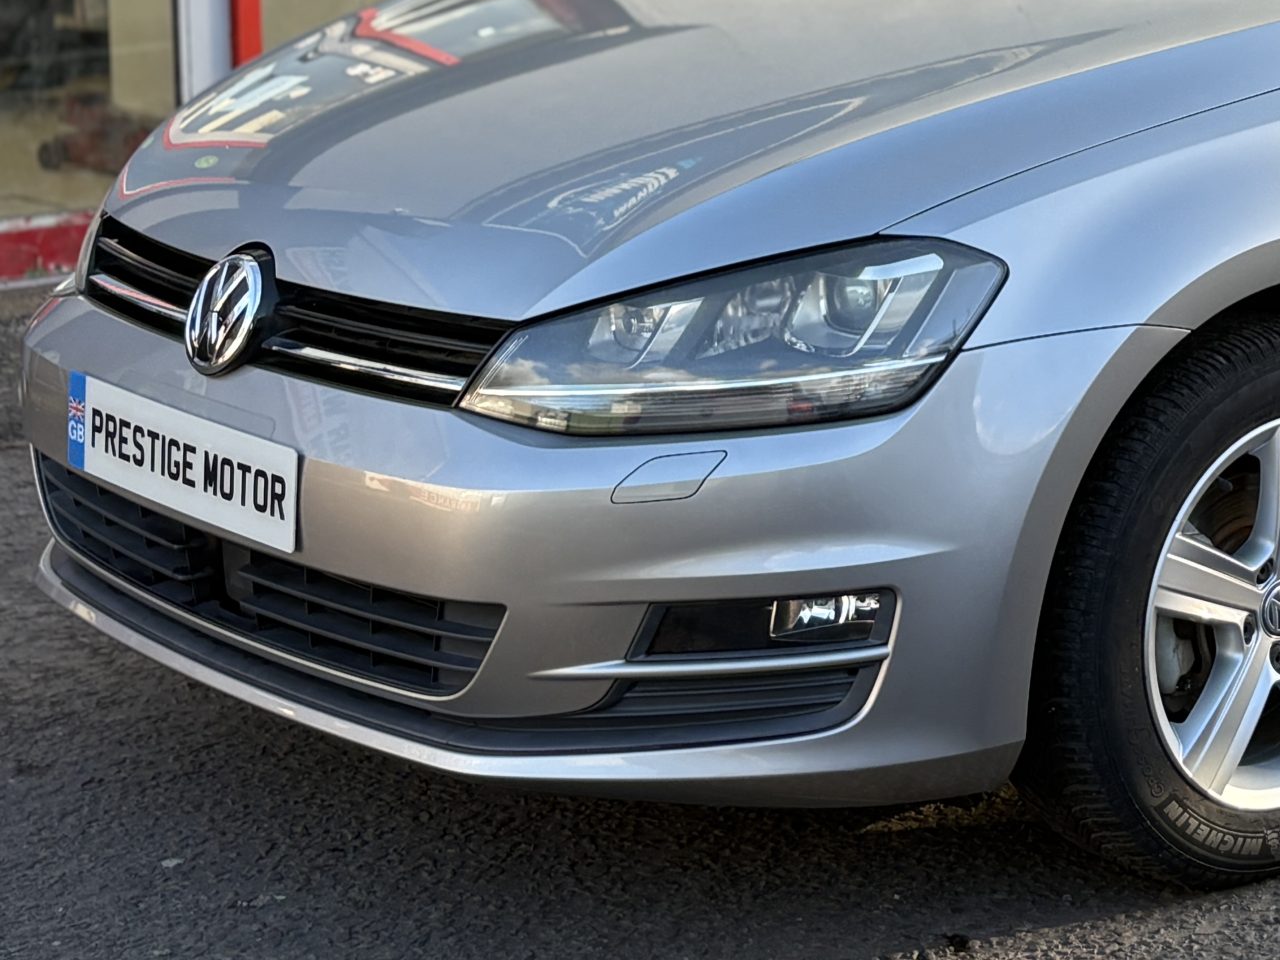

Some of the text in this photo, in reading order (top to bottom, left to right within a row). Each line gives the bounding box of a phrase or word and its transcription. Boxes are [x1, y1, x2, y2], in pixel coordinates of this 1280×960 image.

[67, 420, 85, 444] GB
[91, 407, 286, 521] PRESTIGE MOTOR
[1163, 800, 1264, 856] MICHELIN
